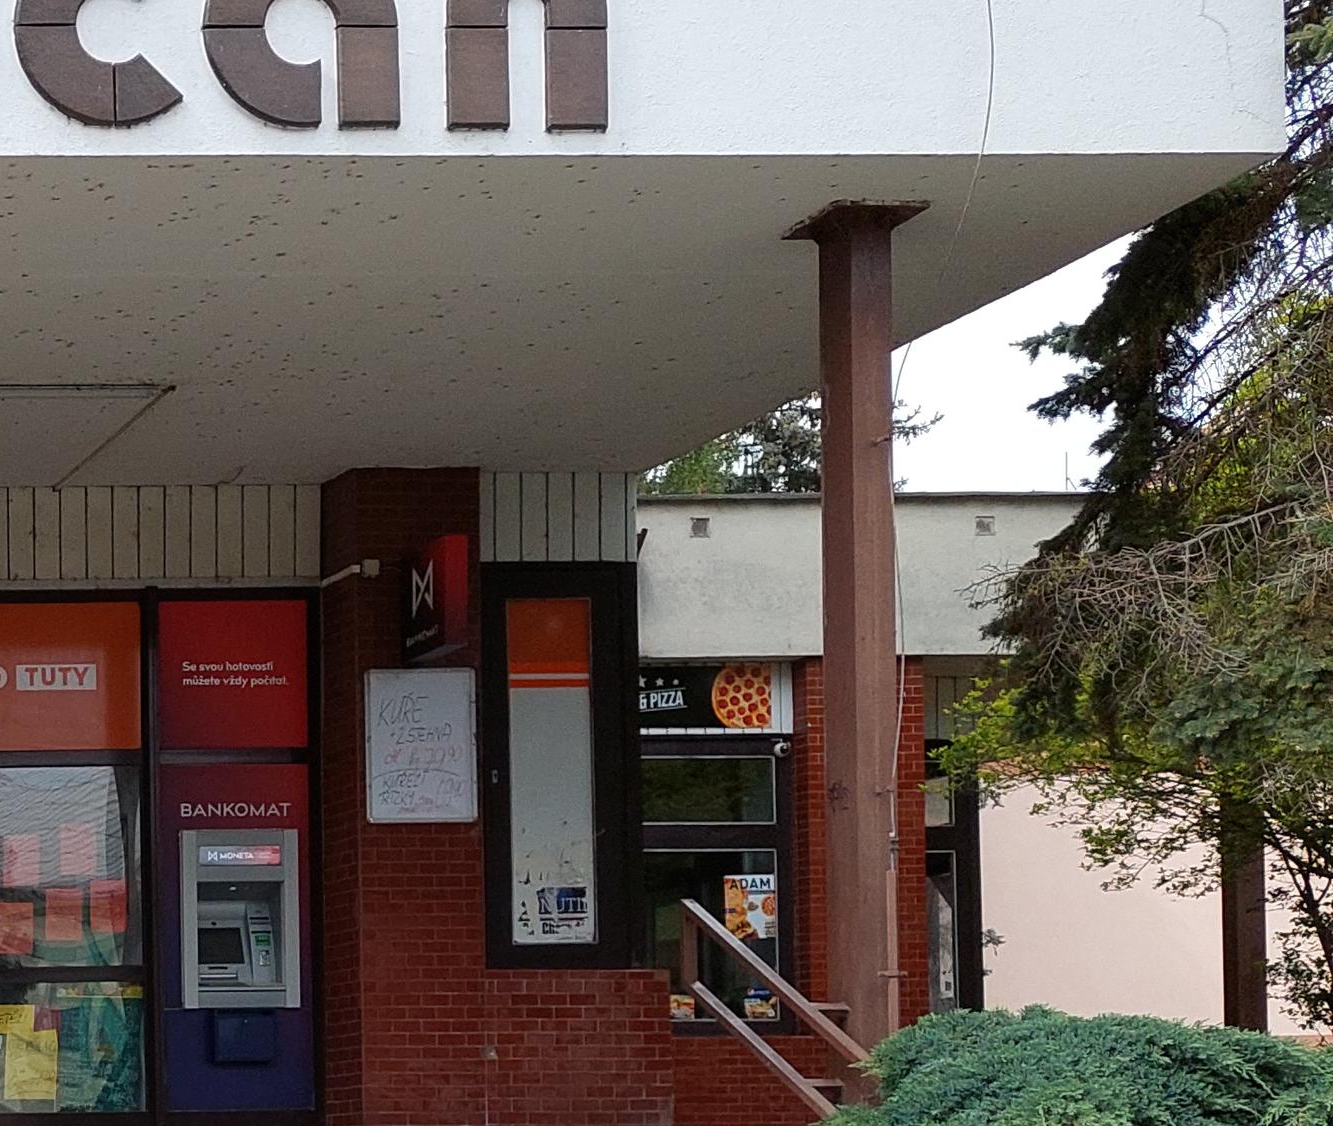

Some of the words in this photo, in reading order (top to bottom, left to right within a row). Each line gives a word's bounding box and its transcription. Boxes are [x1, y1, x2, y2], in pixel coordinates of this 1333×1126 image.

[183, 661, 197, 672] Se
[199, 664, 224, 672] svou
[25, 667, 89, 686] TUTY
[649, 691, 684, 708] PIZZA
[180, 802, 292, 818] BANKOMAT
[219, 852, 255, 860] MONETA
[729, 877, 771, 890] ADAM
